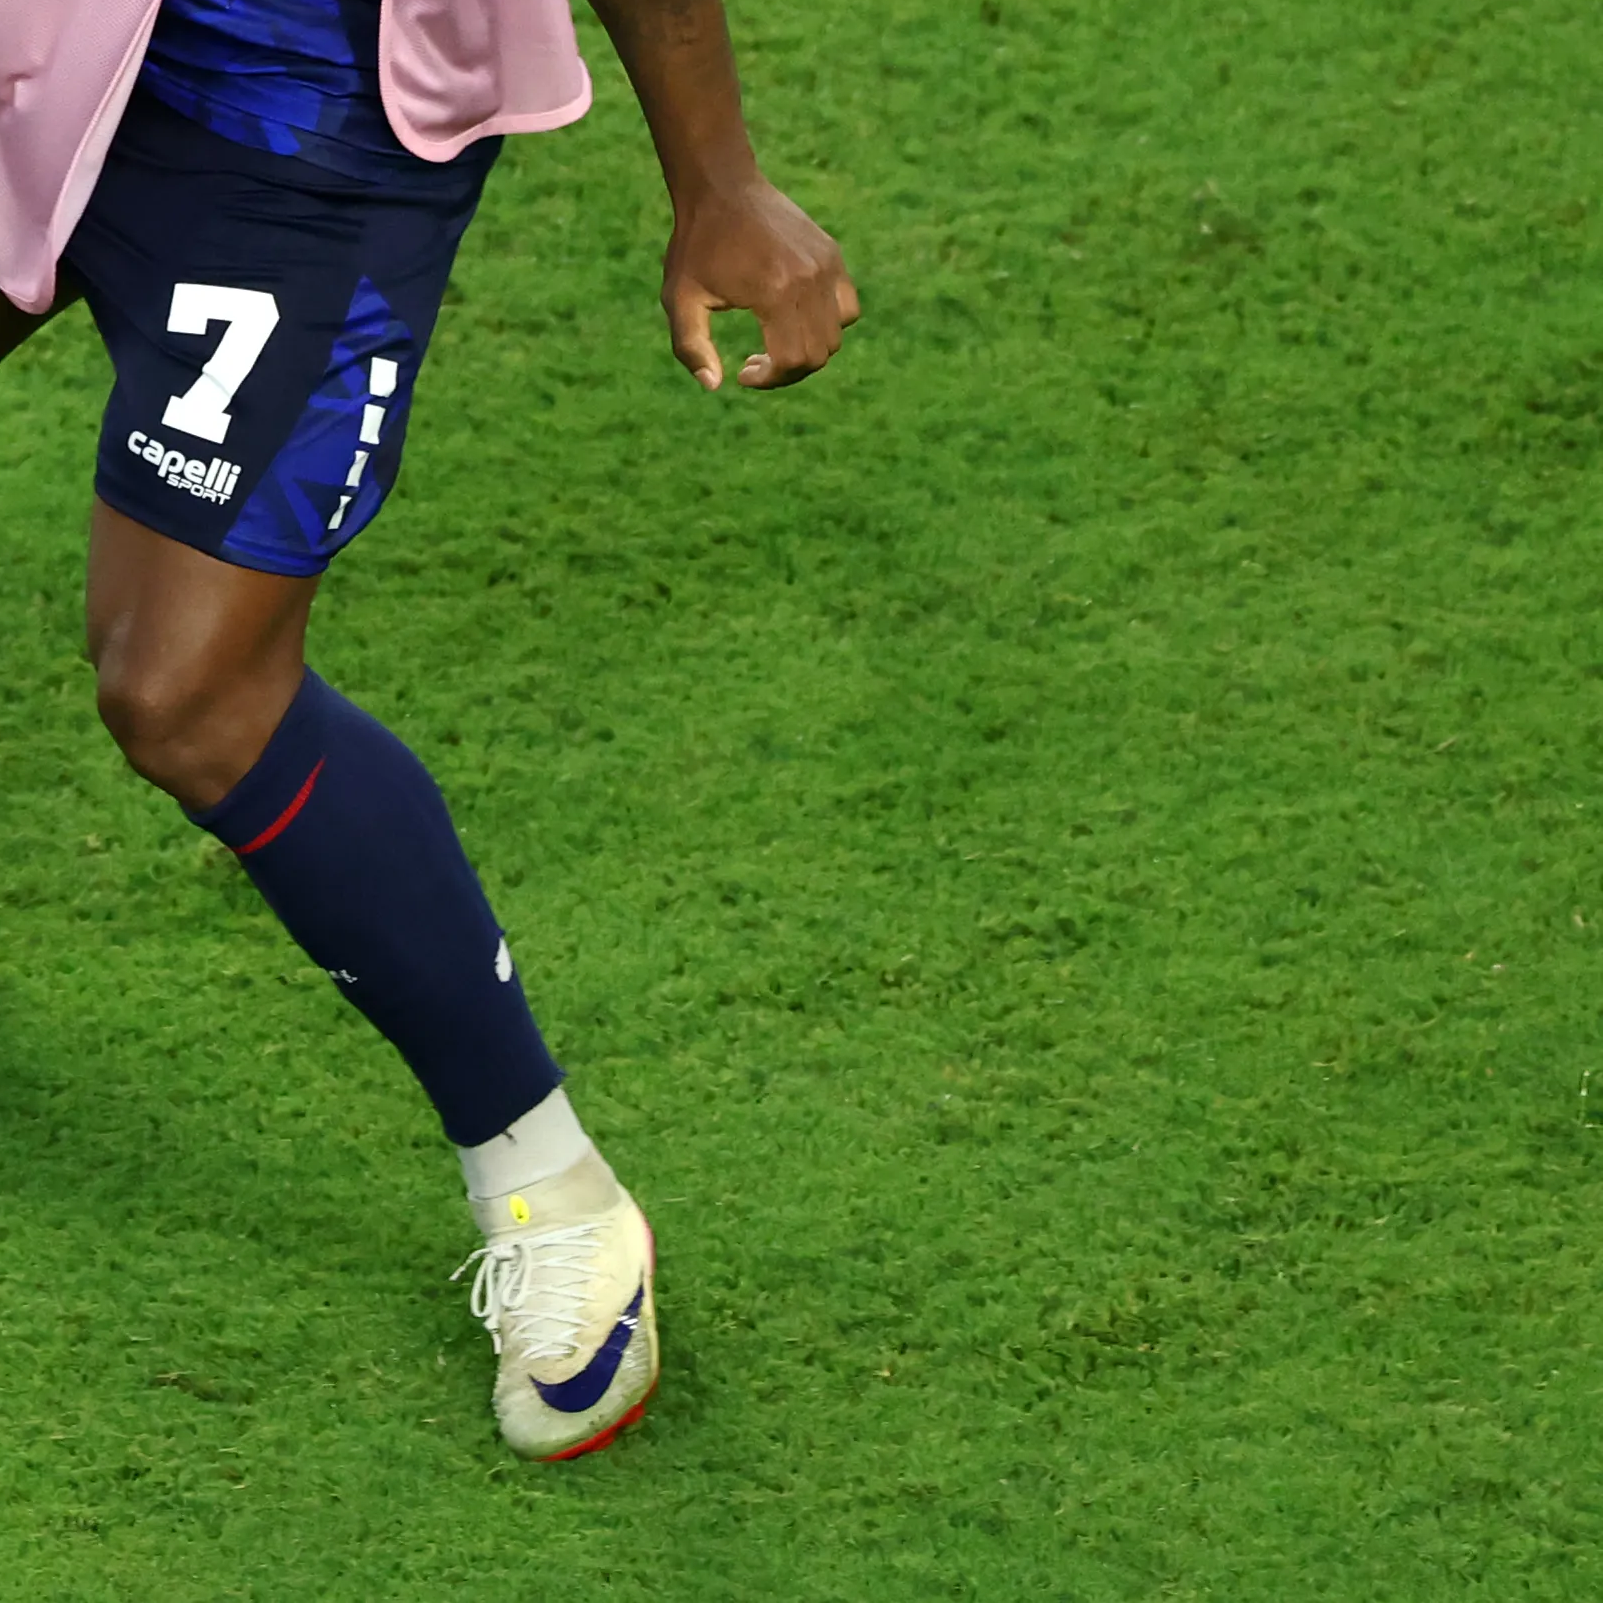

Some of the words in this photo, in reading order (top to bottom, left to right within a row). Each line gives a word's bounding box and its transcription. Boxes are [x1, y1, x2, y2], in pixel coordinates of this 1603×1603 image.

[161, 282, 281, 445] 7
[127, 430, 242, 496] capelli
[166, 473, 231, 506] SPORT
